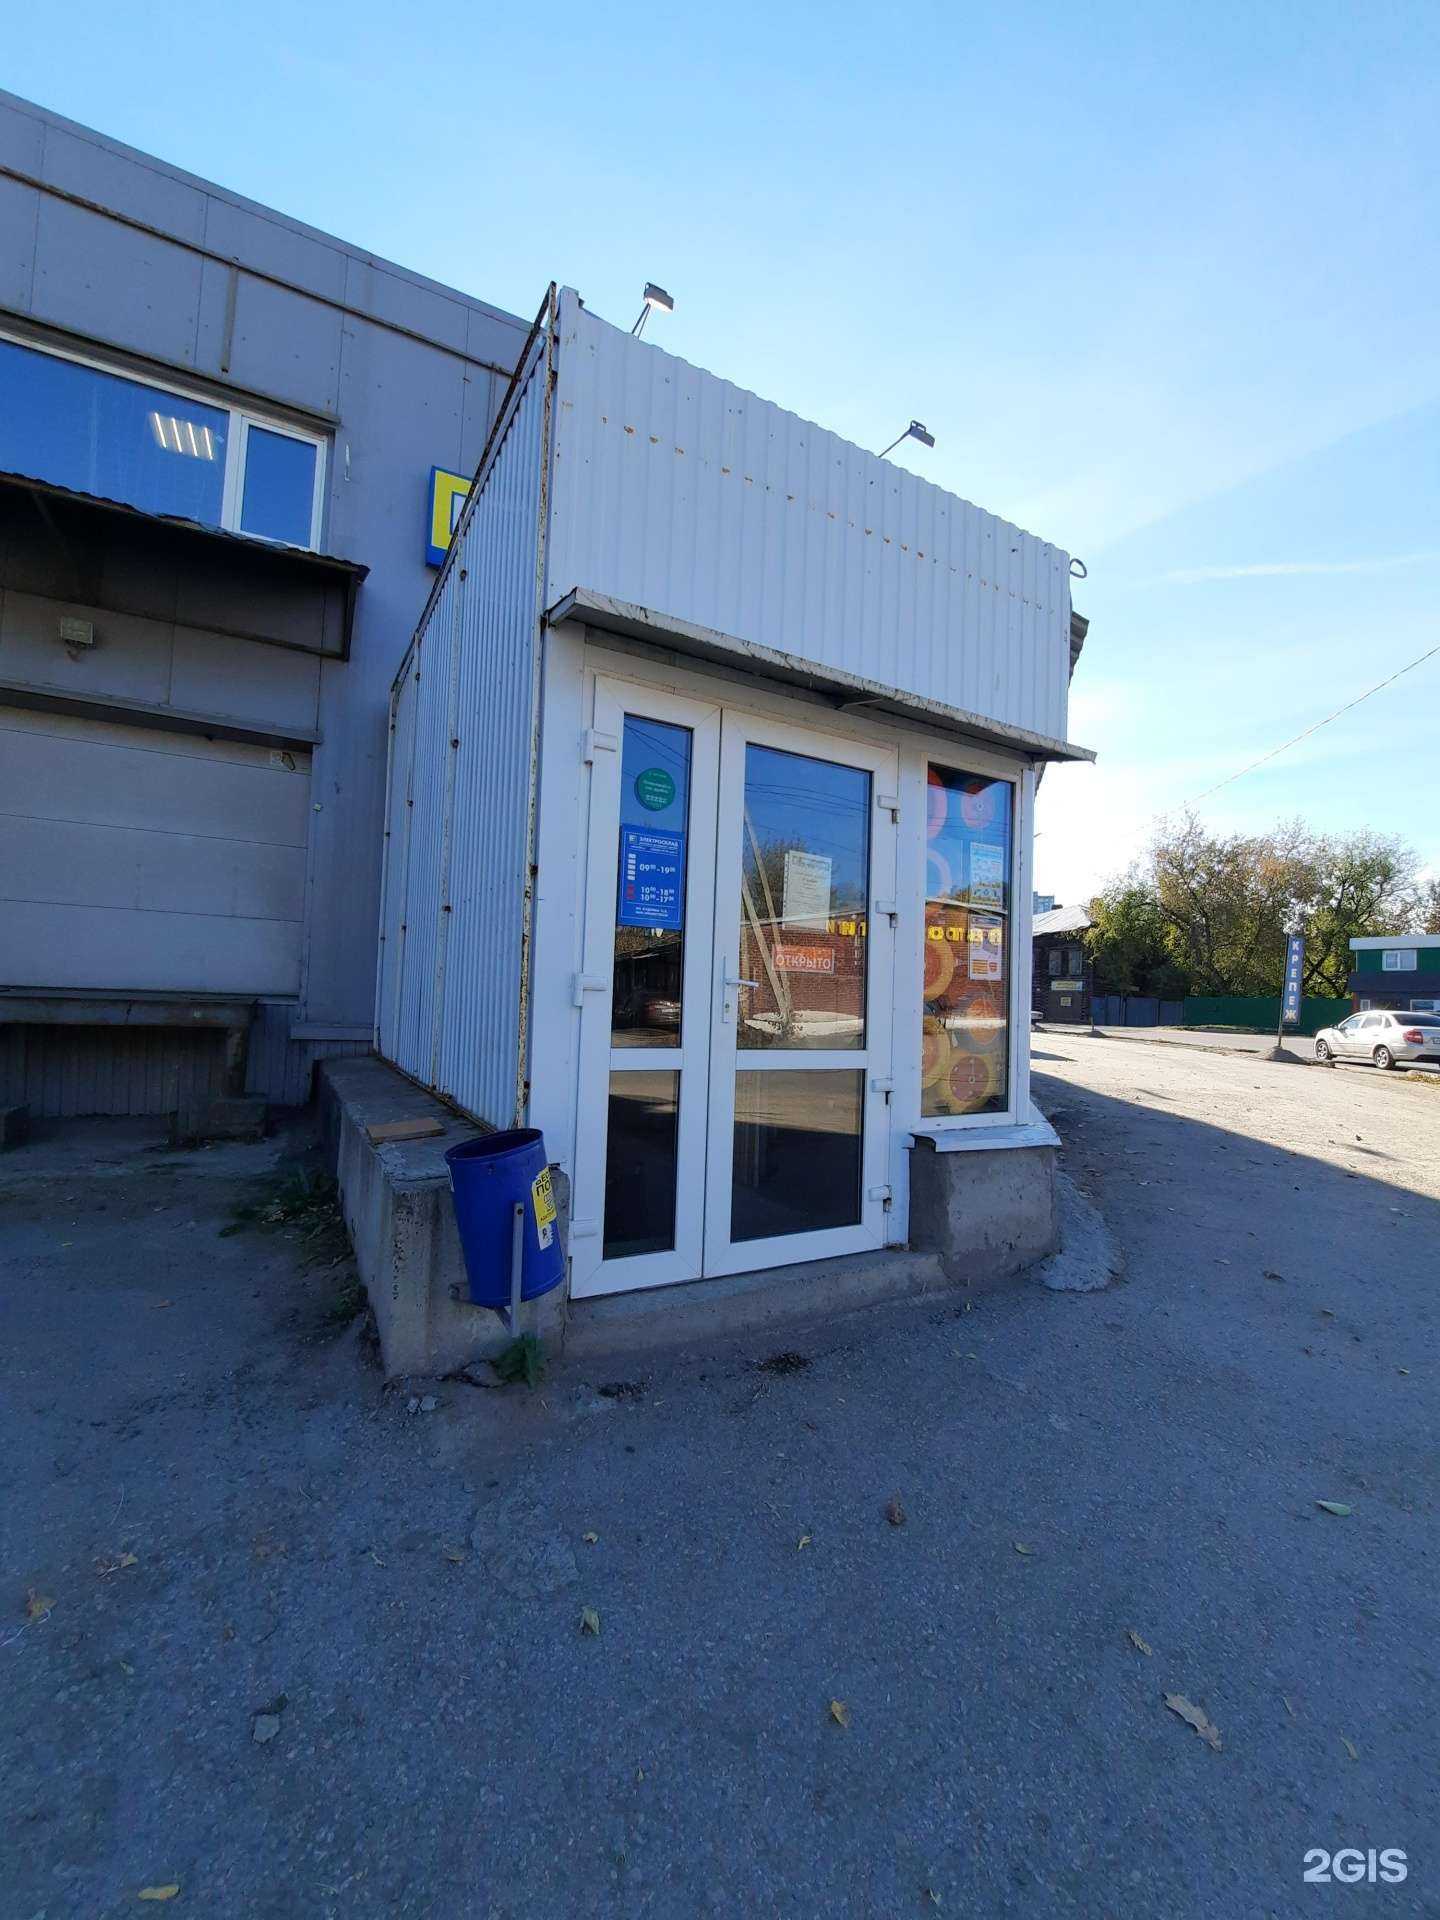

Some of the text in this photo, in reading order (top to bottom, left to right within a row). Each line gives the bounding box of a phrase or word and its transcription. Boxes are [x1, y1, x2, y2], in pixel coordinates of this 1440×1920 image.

[639, 836, 679, 847] ЭЛЕКТРОСКЛАД
[776, 954, 831, 969] ОТКРЫТО
[1284, 940, 1300, 1021] КРЕПЕЖ
